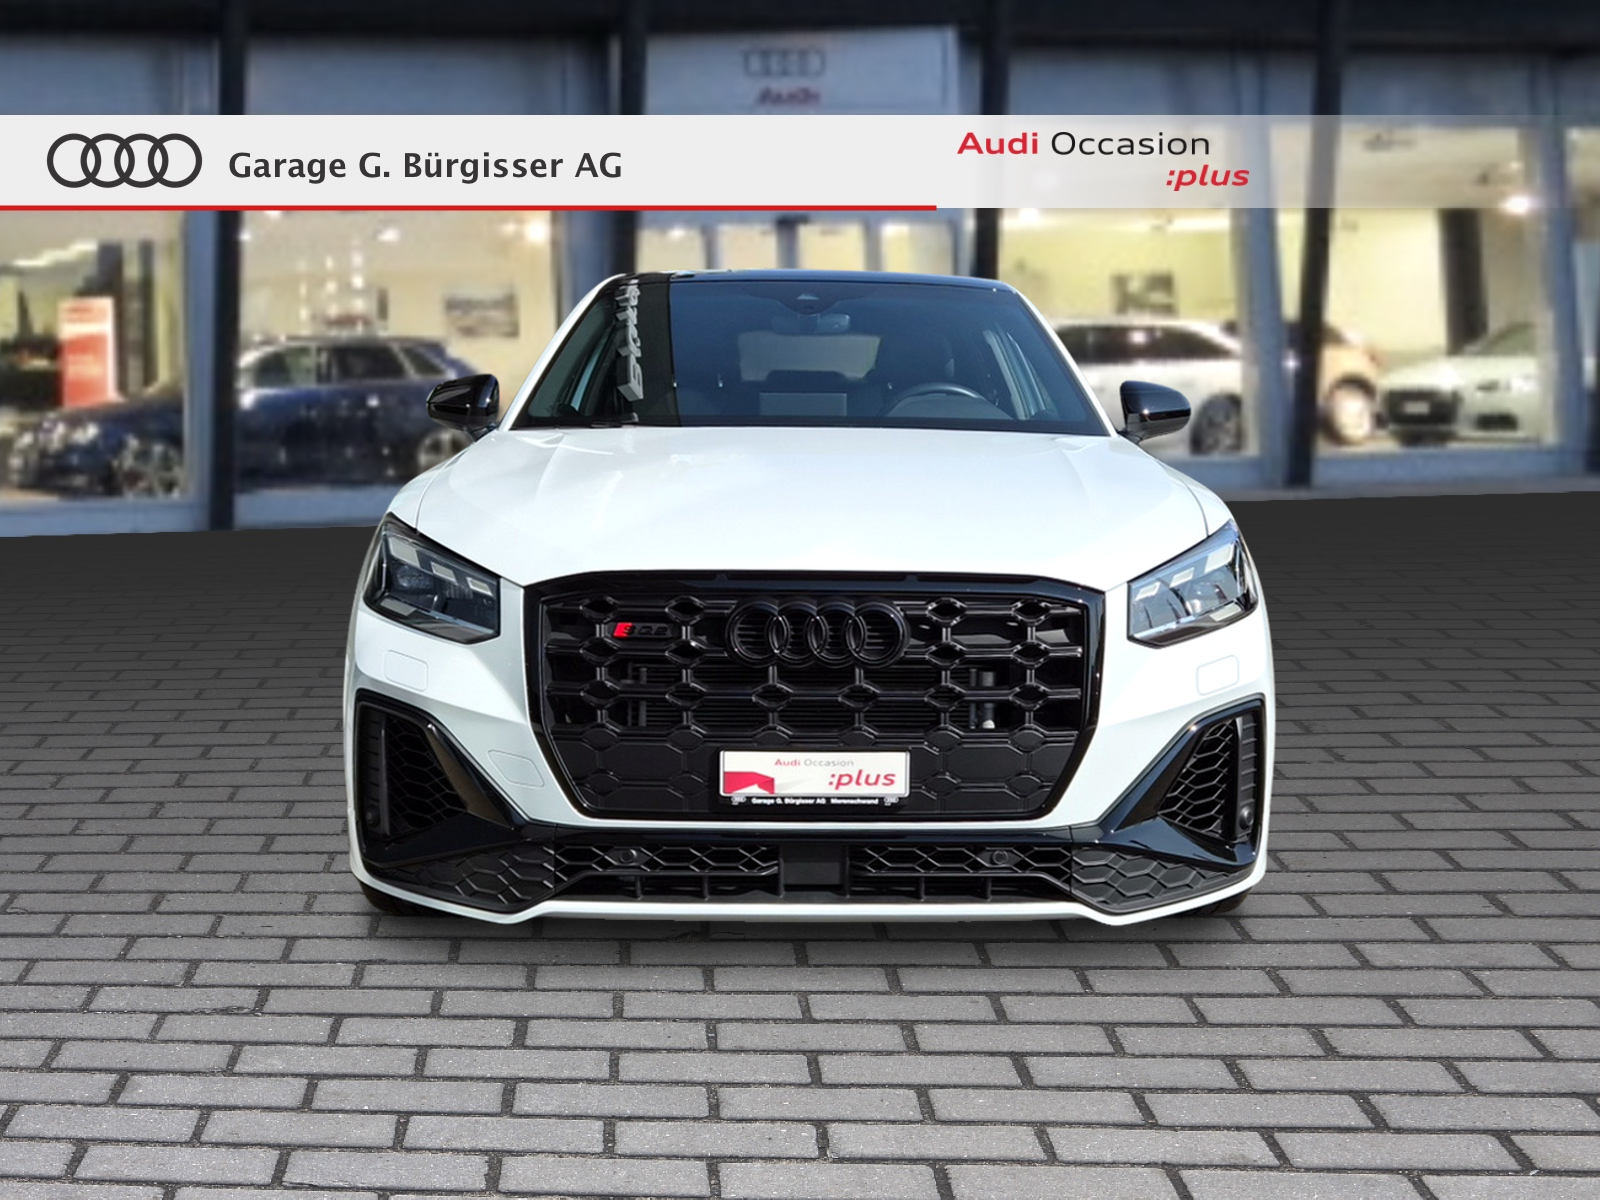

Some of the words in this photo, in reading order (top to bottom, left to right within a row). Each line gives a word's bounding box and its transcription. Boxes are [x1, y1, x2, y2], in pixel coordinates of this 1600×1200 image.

[774, 758, 801, 767] Audi
[803, 758, 854, 767] Occasion
[828, 769, 897, 791] :plus
